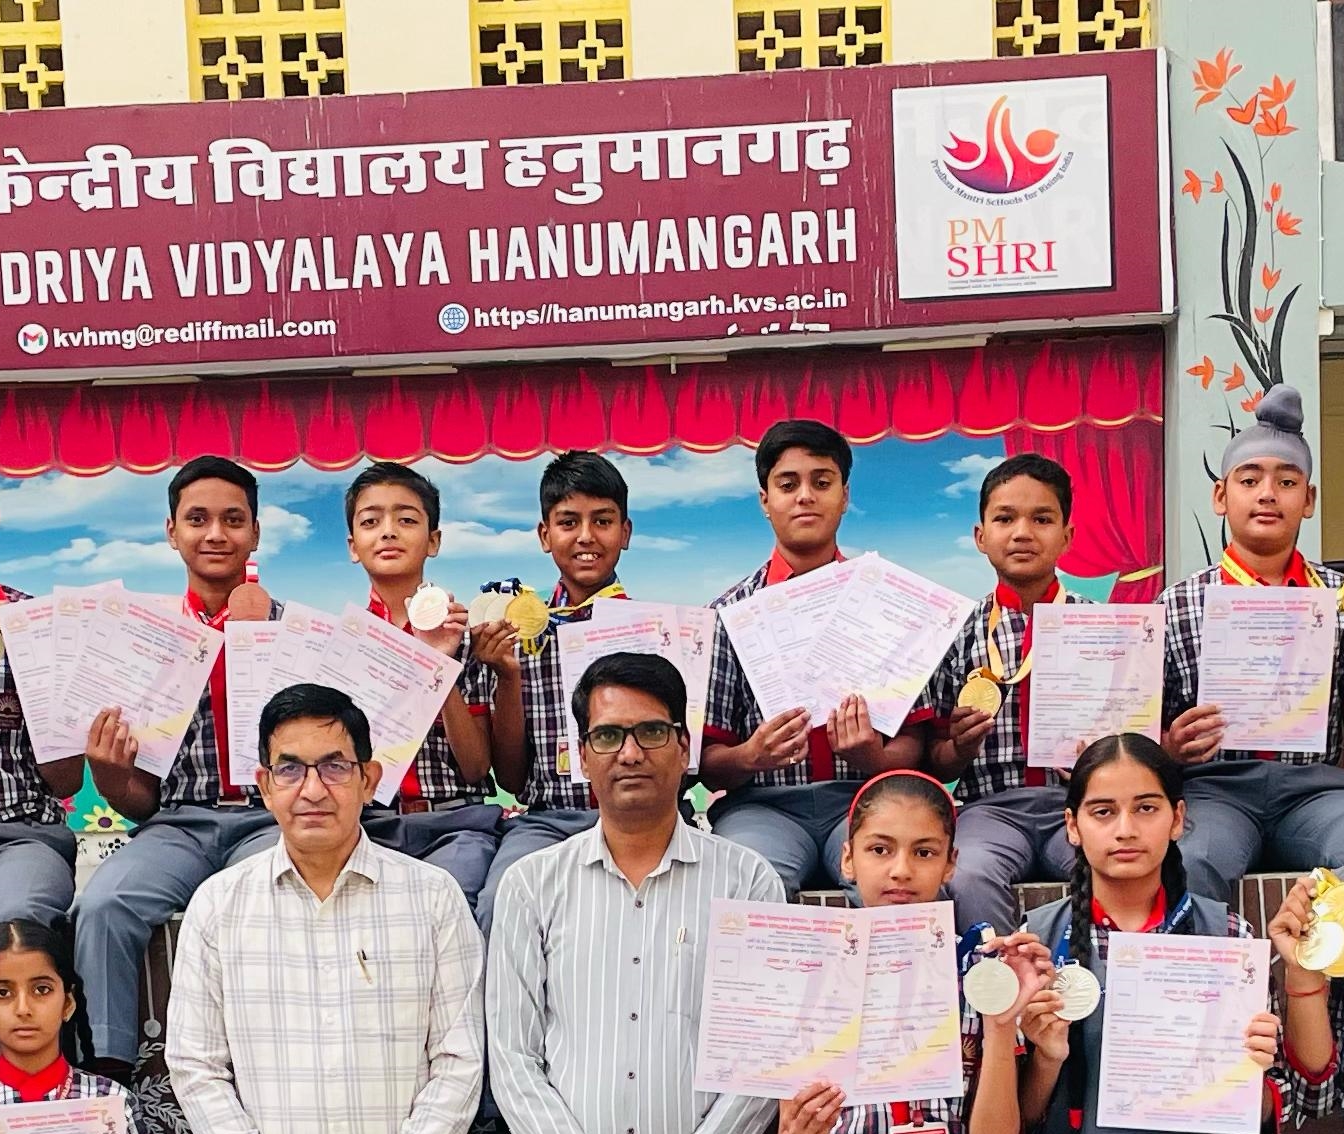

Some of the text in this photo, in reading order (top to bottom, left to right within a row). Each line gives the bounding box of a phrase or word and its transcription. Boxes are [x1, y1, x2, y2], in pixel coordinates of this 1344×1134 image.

[207, 137, 490, 204] विद्यालय
[499, 118, 852, 205] हनुमानगढ़
[946, 216, 1007, 247] PM
[168, 230, 451, 298] VIDYALAYA
[469, 207, 857, 283] HANUMANGARH
[946, 240, 1059, 278] SHRI
[474, 288, 847, 331] https//hanumangarh.kvs.ac.in
[52, 318, 337, 350] kvhmg@rediffmail.com
